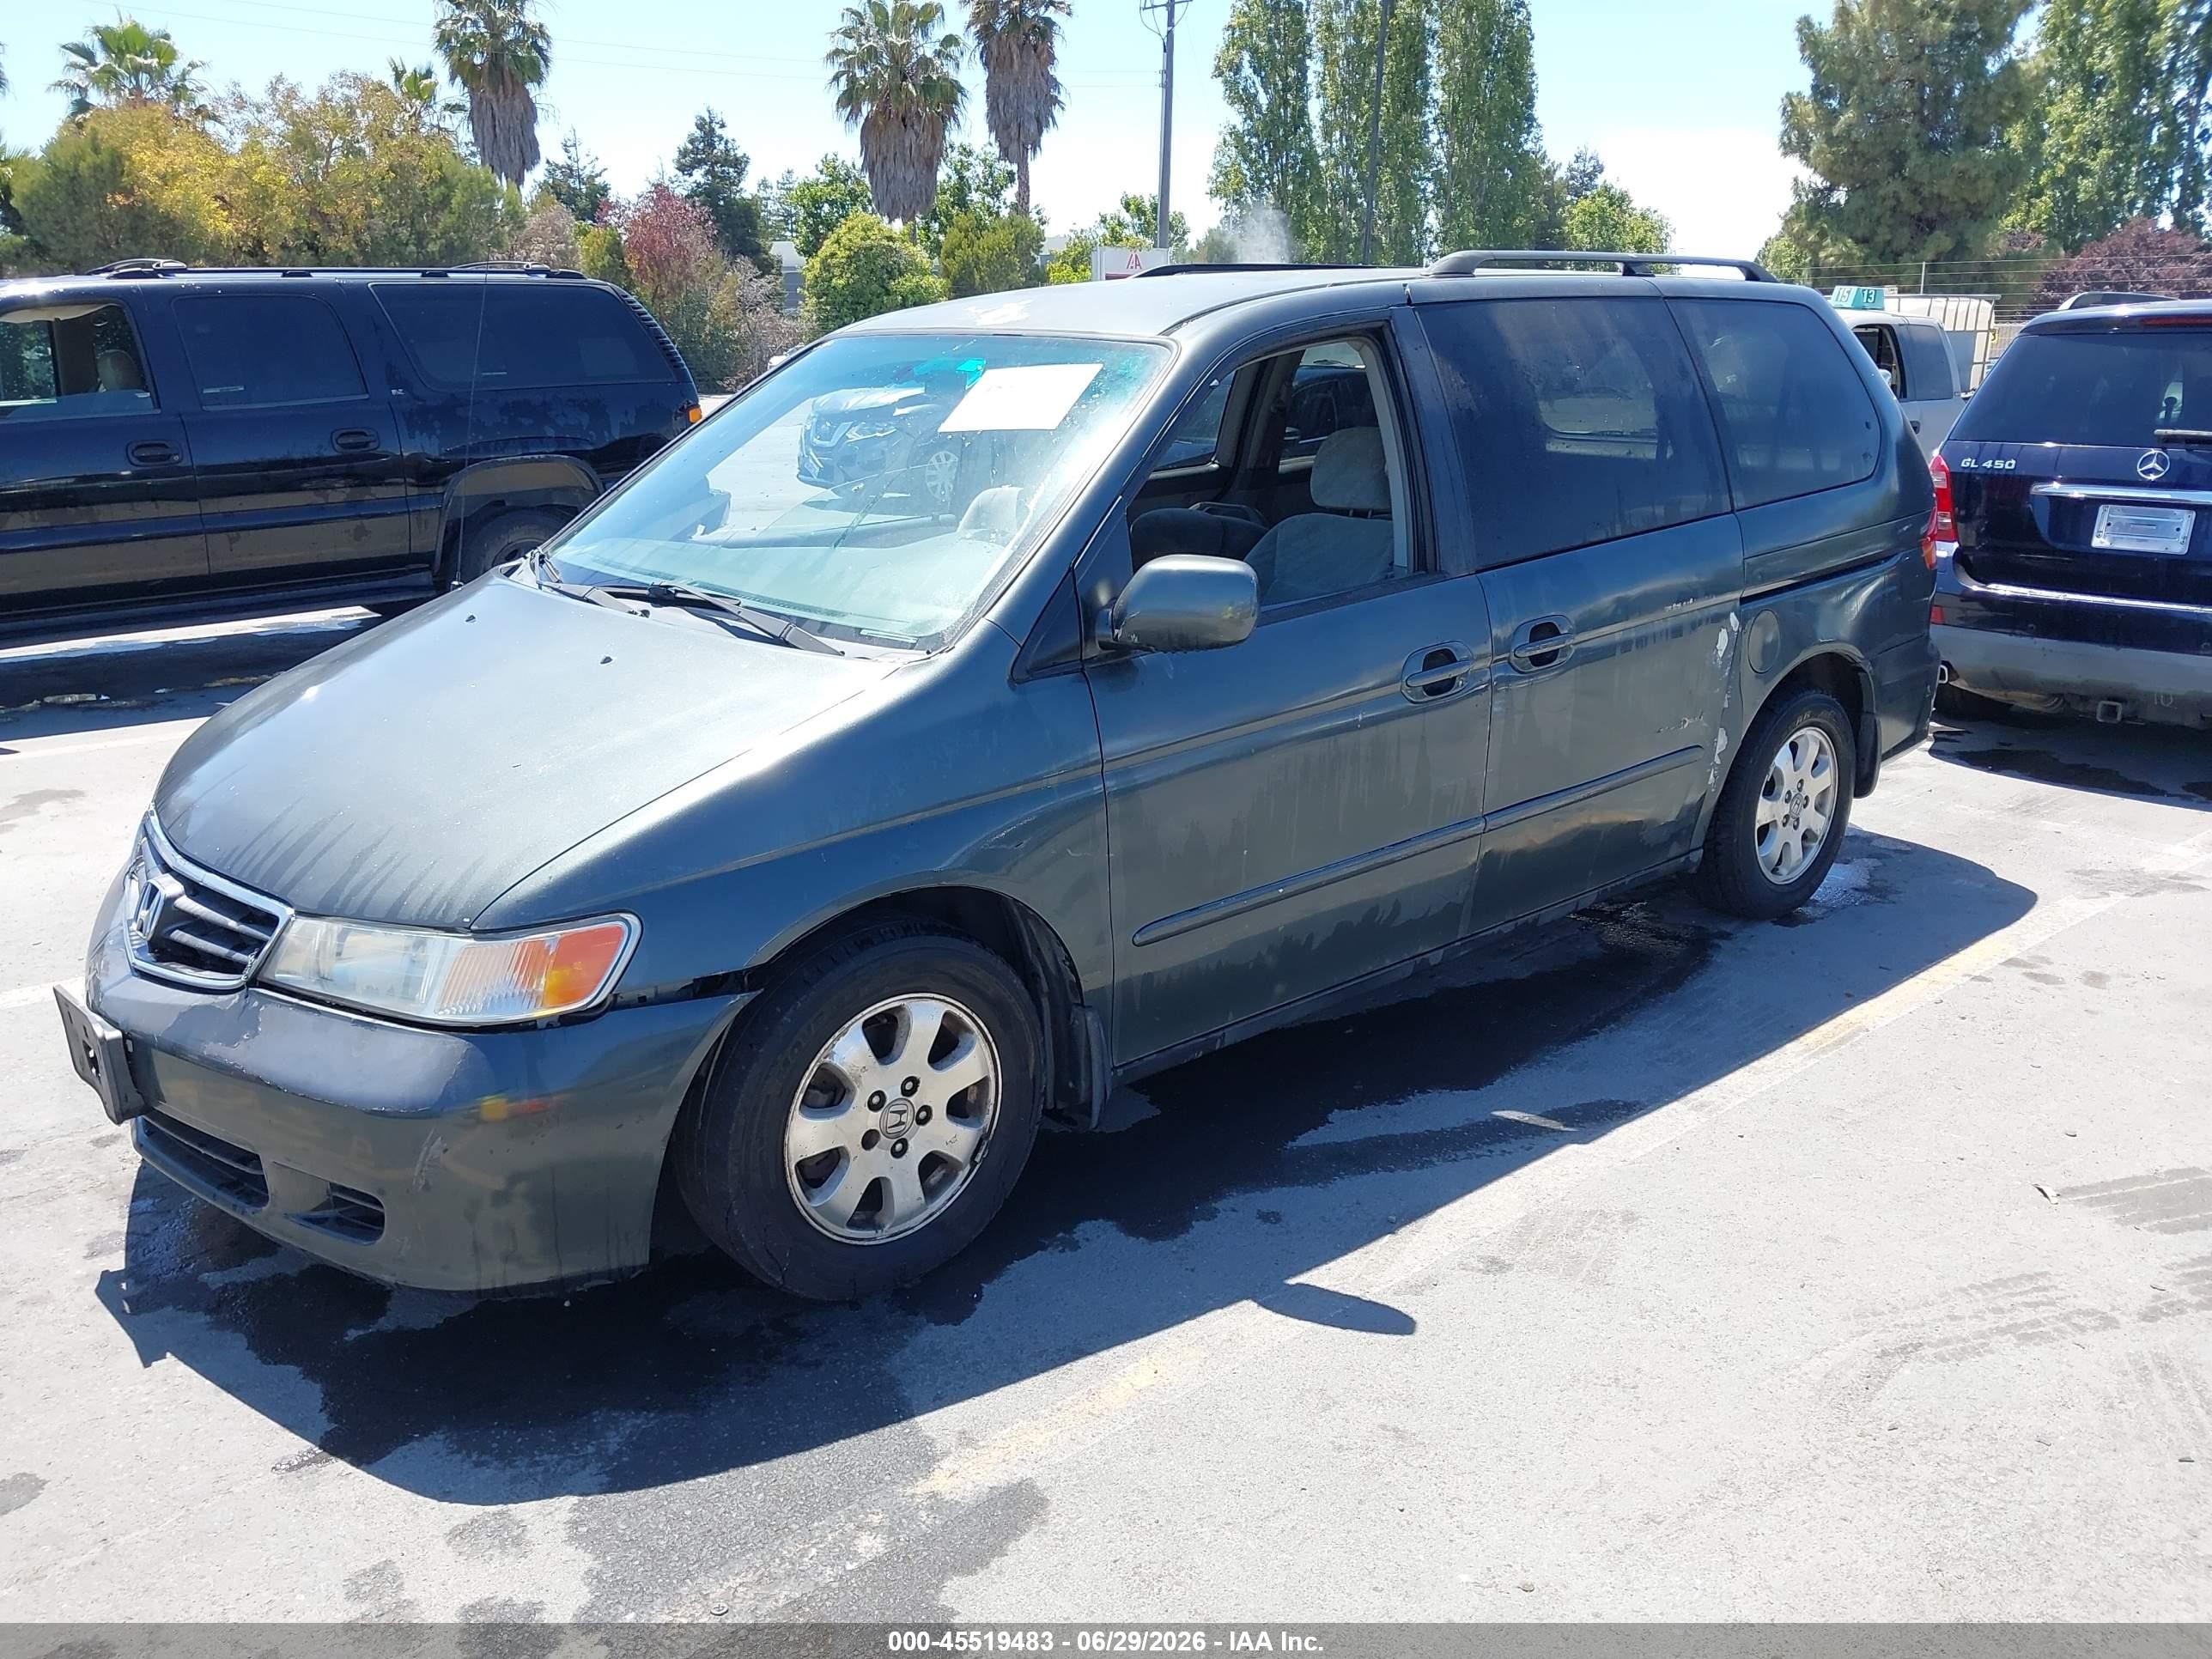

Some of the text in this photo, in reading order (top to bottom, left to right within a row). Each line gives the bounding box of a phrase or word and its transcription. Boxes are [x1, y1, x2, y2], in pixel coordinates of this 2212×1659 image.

[1835, 287, 1851, 303] 15
[1862, 289, 1876, 304] 13
[1960, 458, 2016, 470] GL 450
